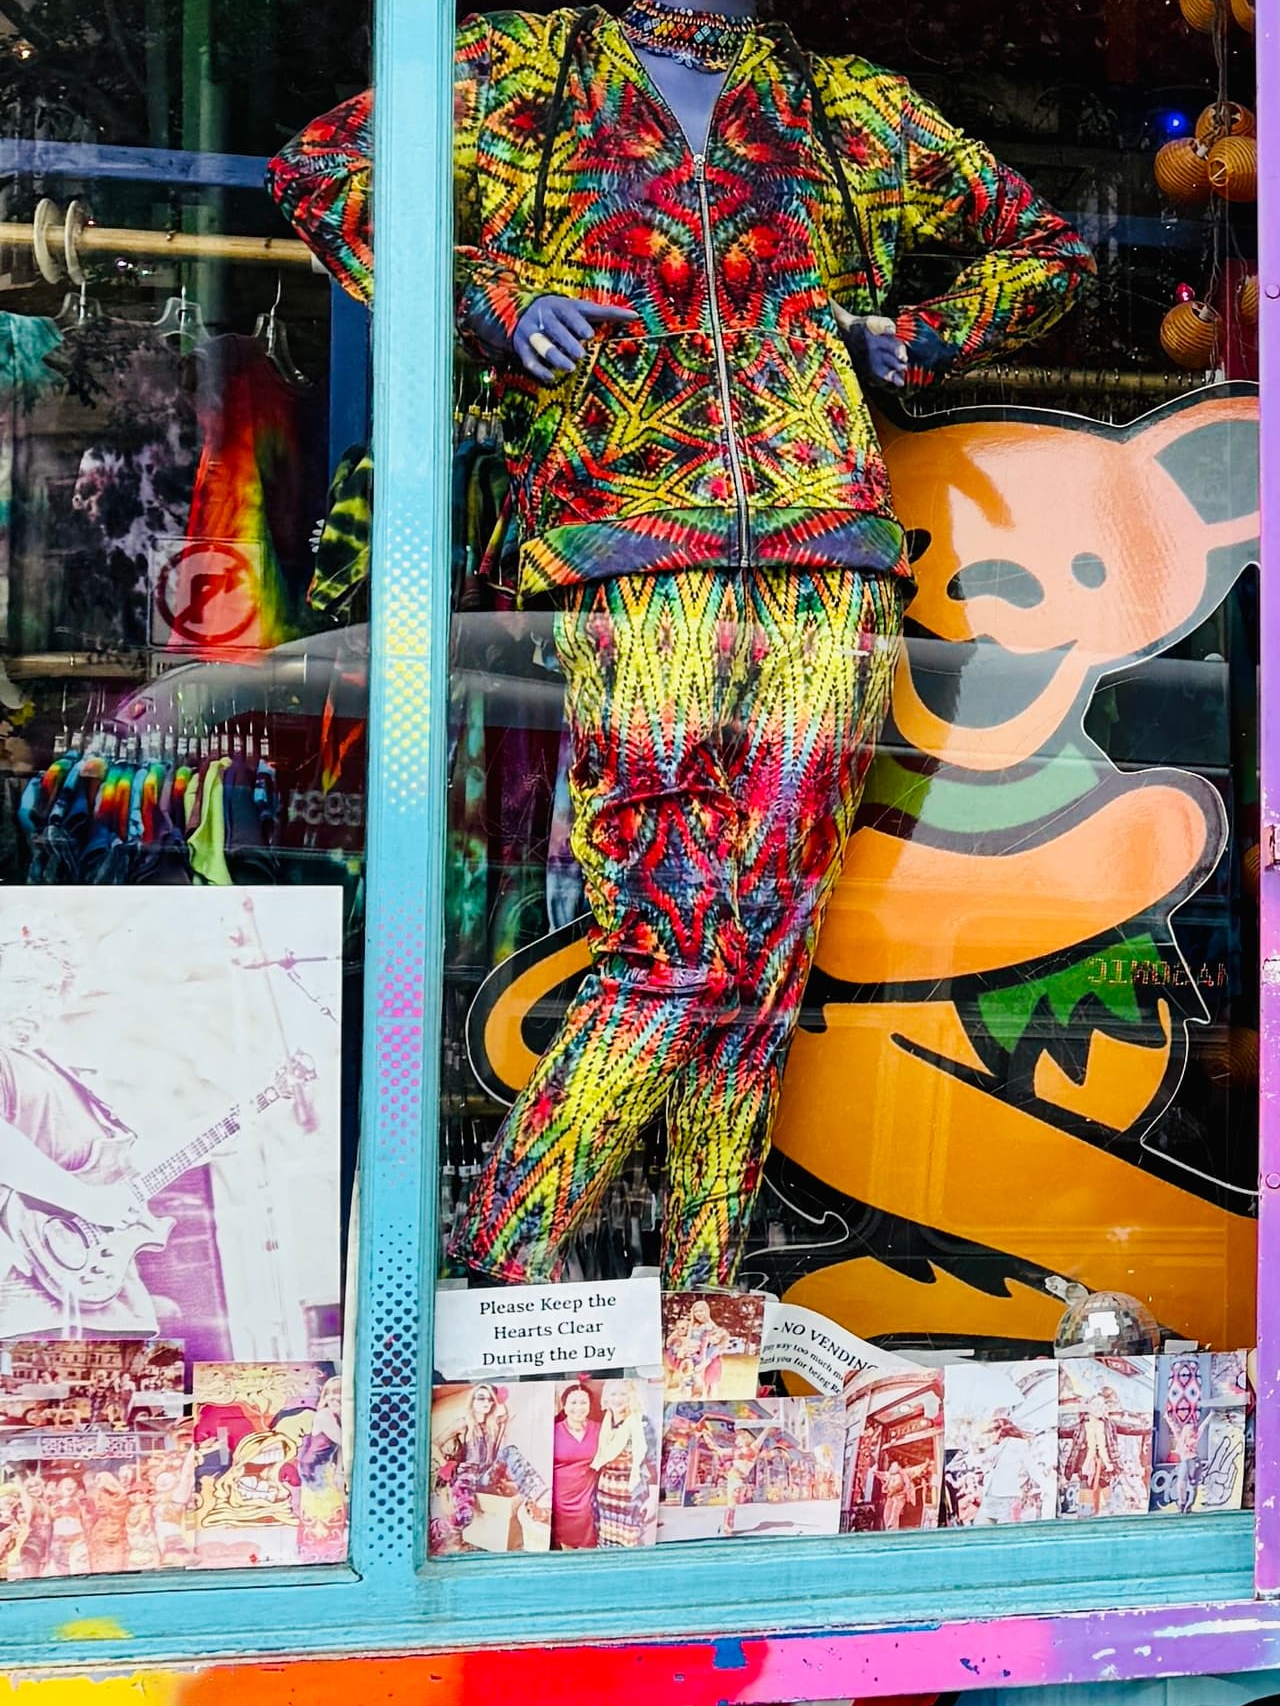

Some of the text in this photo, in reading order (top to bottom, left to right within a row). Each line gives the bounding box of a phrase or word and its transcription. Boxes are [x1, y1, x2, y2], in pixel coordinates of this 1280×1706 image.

[480, 1293, 617, 1315] Please Keep the
[494, 1321, 604, 1340] Hearts Clear
[482, 1345, 617, 1366] During the Day
[793, 1344, 809, 1355] too
[810, 1353, 833, 1373] much
[793, 1357, 807, 1369] for
[808, 1366, 831, 1389] being
